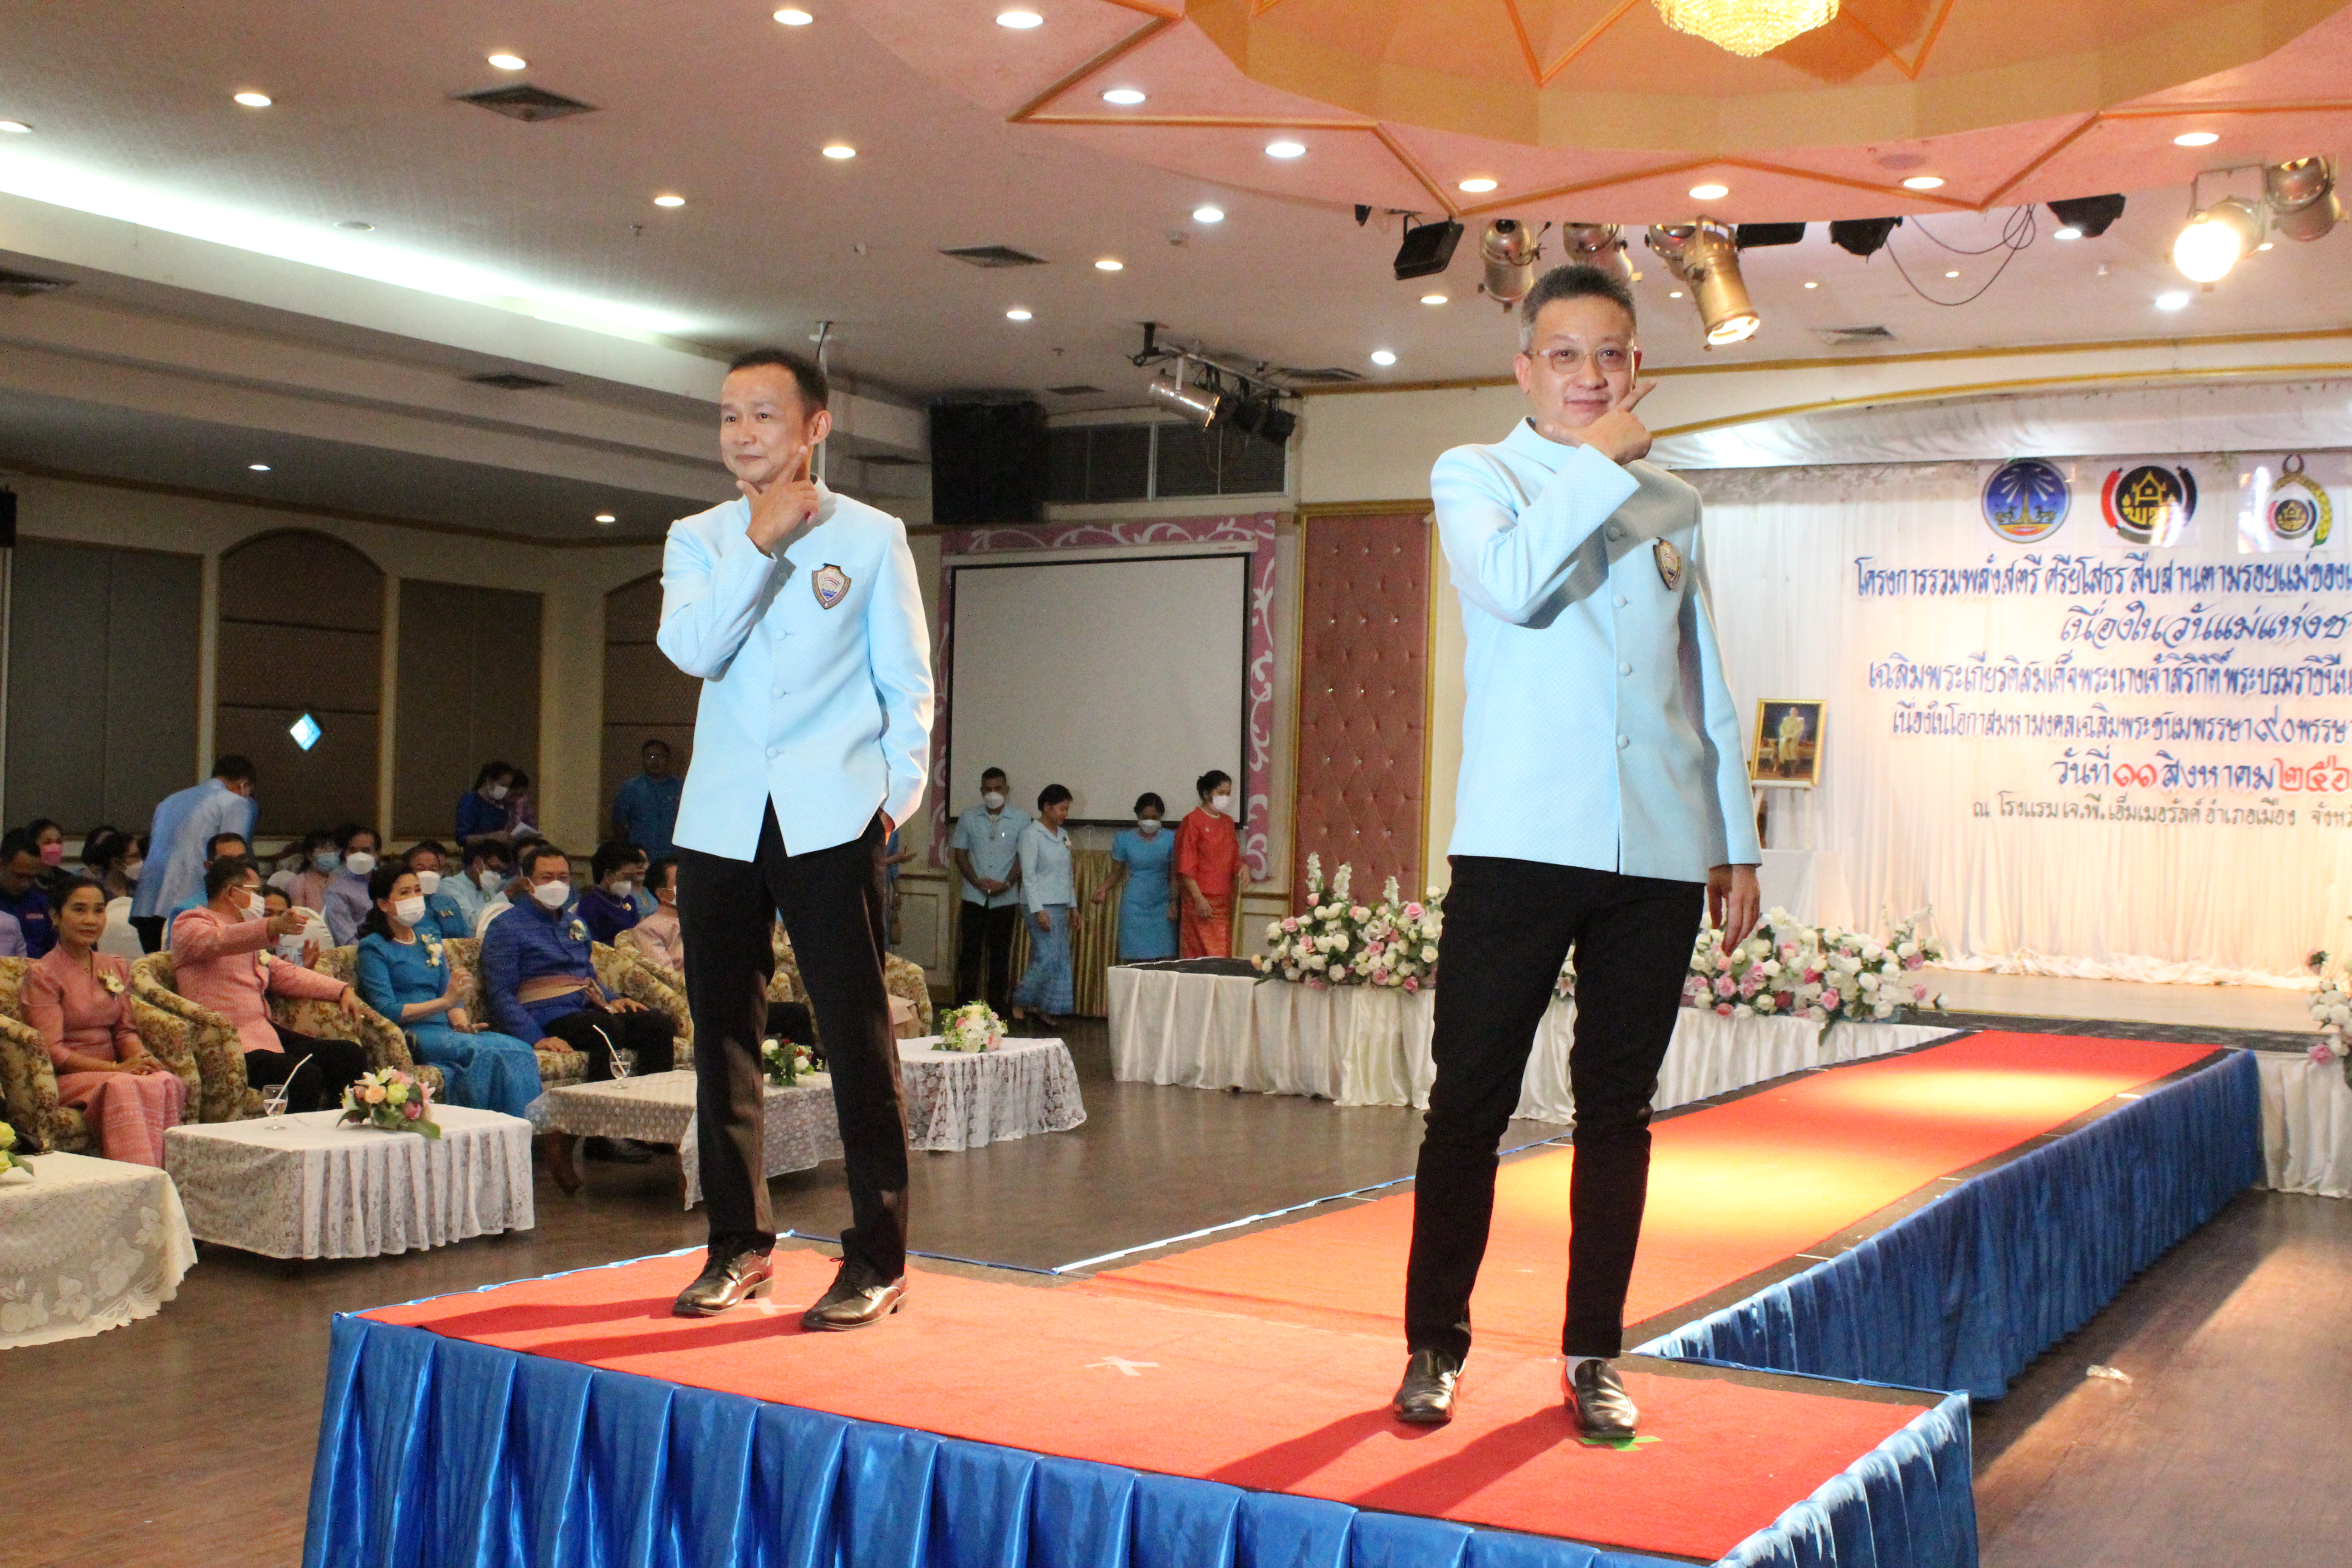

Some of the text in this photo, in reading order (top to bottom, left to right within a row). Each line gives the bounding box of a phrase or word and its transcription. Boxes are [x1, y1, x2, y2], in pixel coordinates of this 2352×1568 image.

[2062, 600, 2352, 649] เนื่องในวันแม่แห่งช
[1973, 802, 1989, 817] ณ
[1999, 791, 2058, 818] โรงแรม
